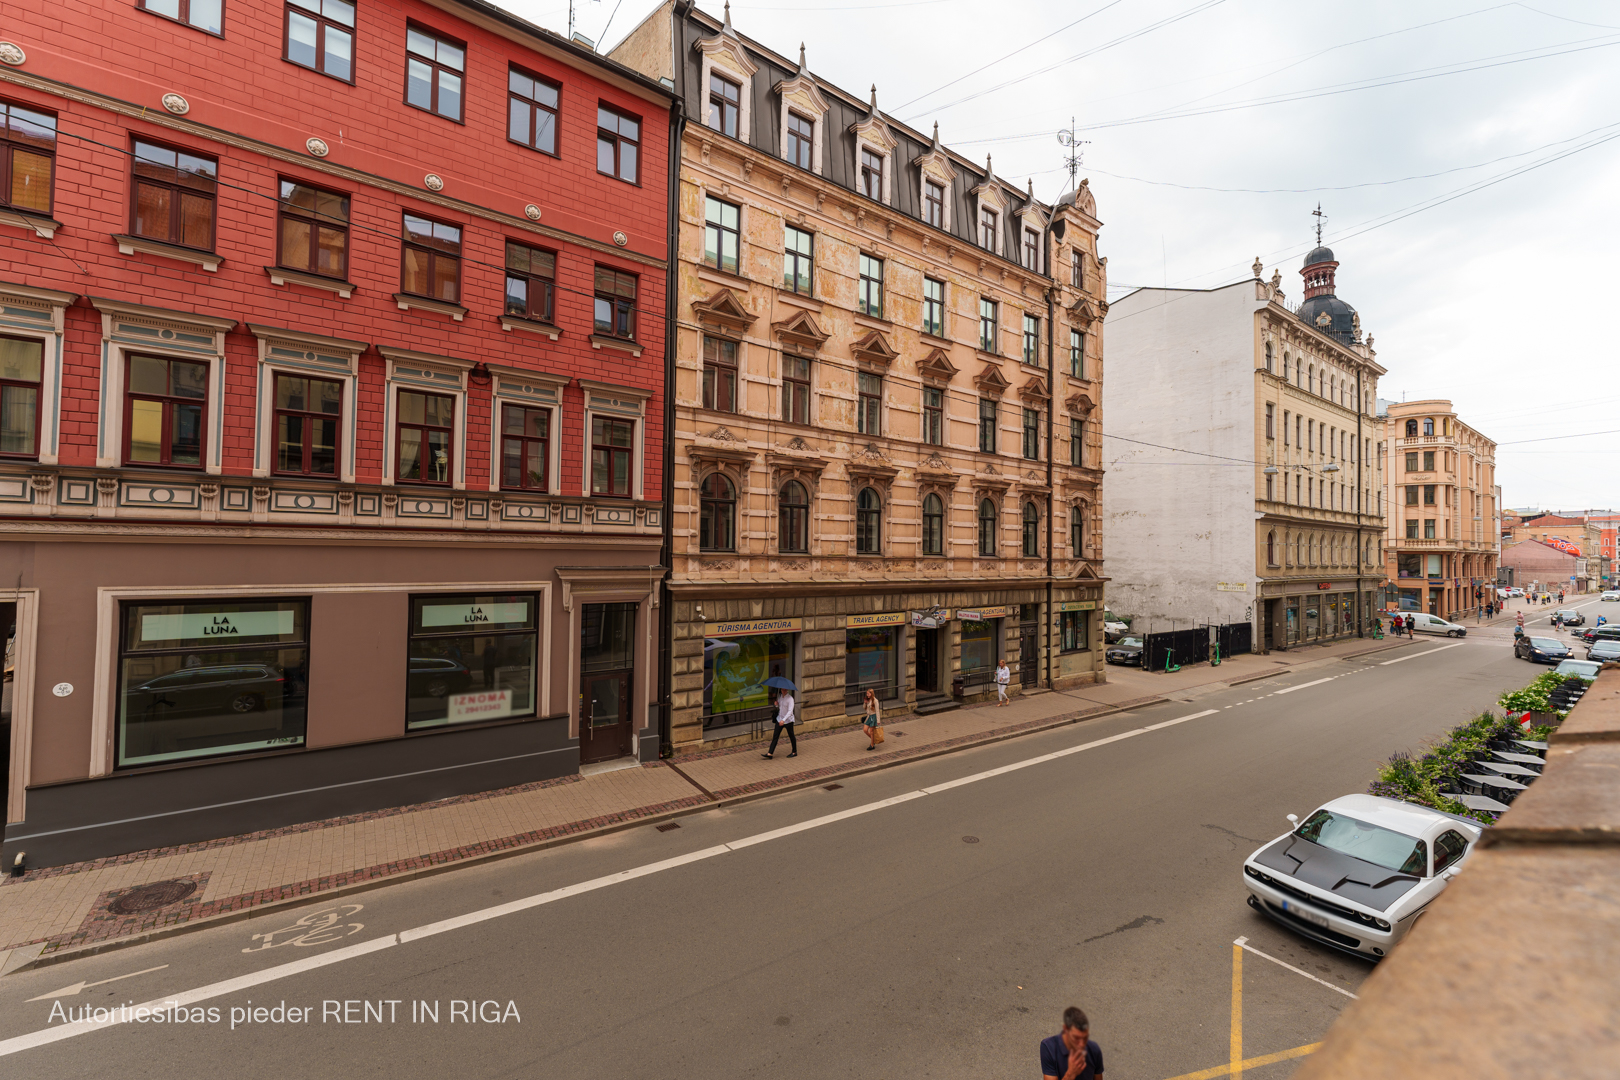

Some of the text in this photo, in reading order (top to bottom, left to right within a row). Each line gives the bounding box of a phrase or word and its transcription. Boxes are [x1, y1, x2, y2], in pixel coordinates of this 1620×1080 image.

[471, 606, 483, 614] LA
[213, 616, 230, 625] LA
[464, 614, 489, 623] LUNA
[853, 614, 900, 624] TRAVEL AGENCY
[204, 625, 238, 635] LUNA
[717, 620, 792, 633] TŪRISMA AĢENTŪRA
